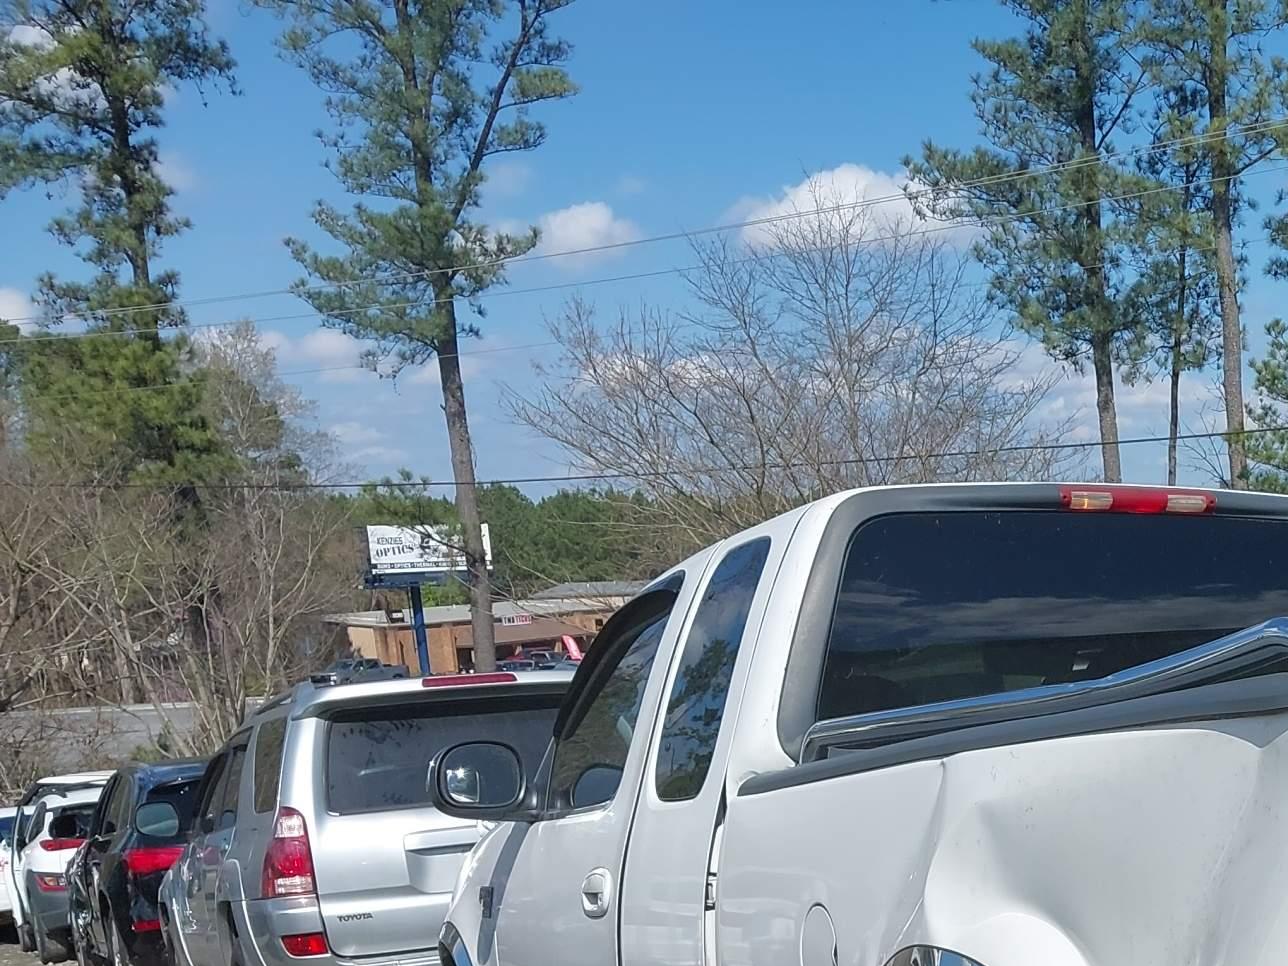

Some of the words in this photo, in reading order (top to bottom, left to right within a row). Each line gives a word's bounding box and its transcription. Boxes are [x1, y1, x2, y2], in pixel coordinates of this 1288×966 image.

[376, 536, 403, 545] KENZIES
[376, 544, 415, 558] OPTICS
[336, 912, 374, 922] TOYOTA
